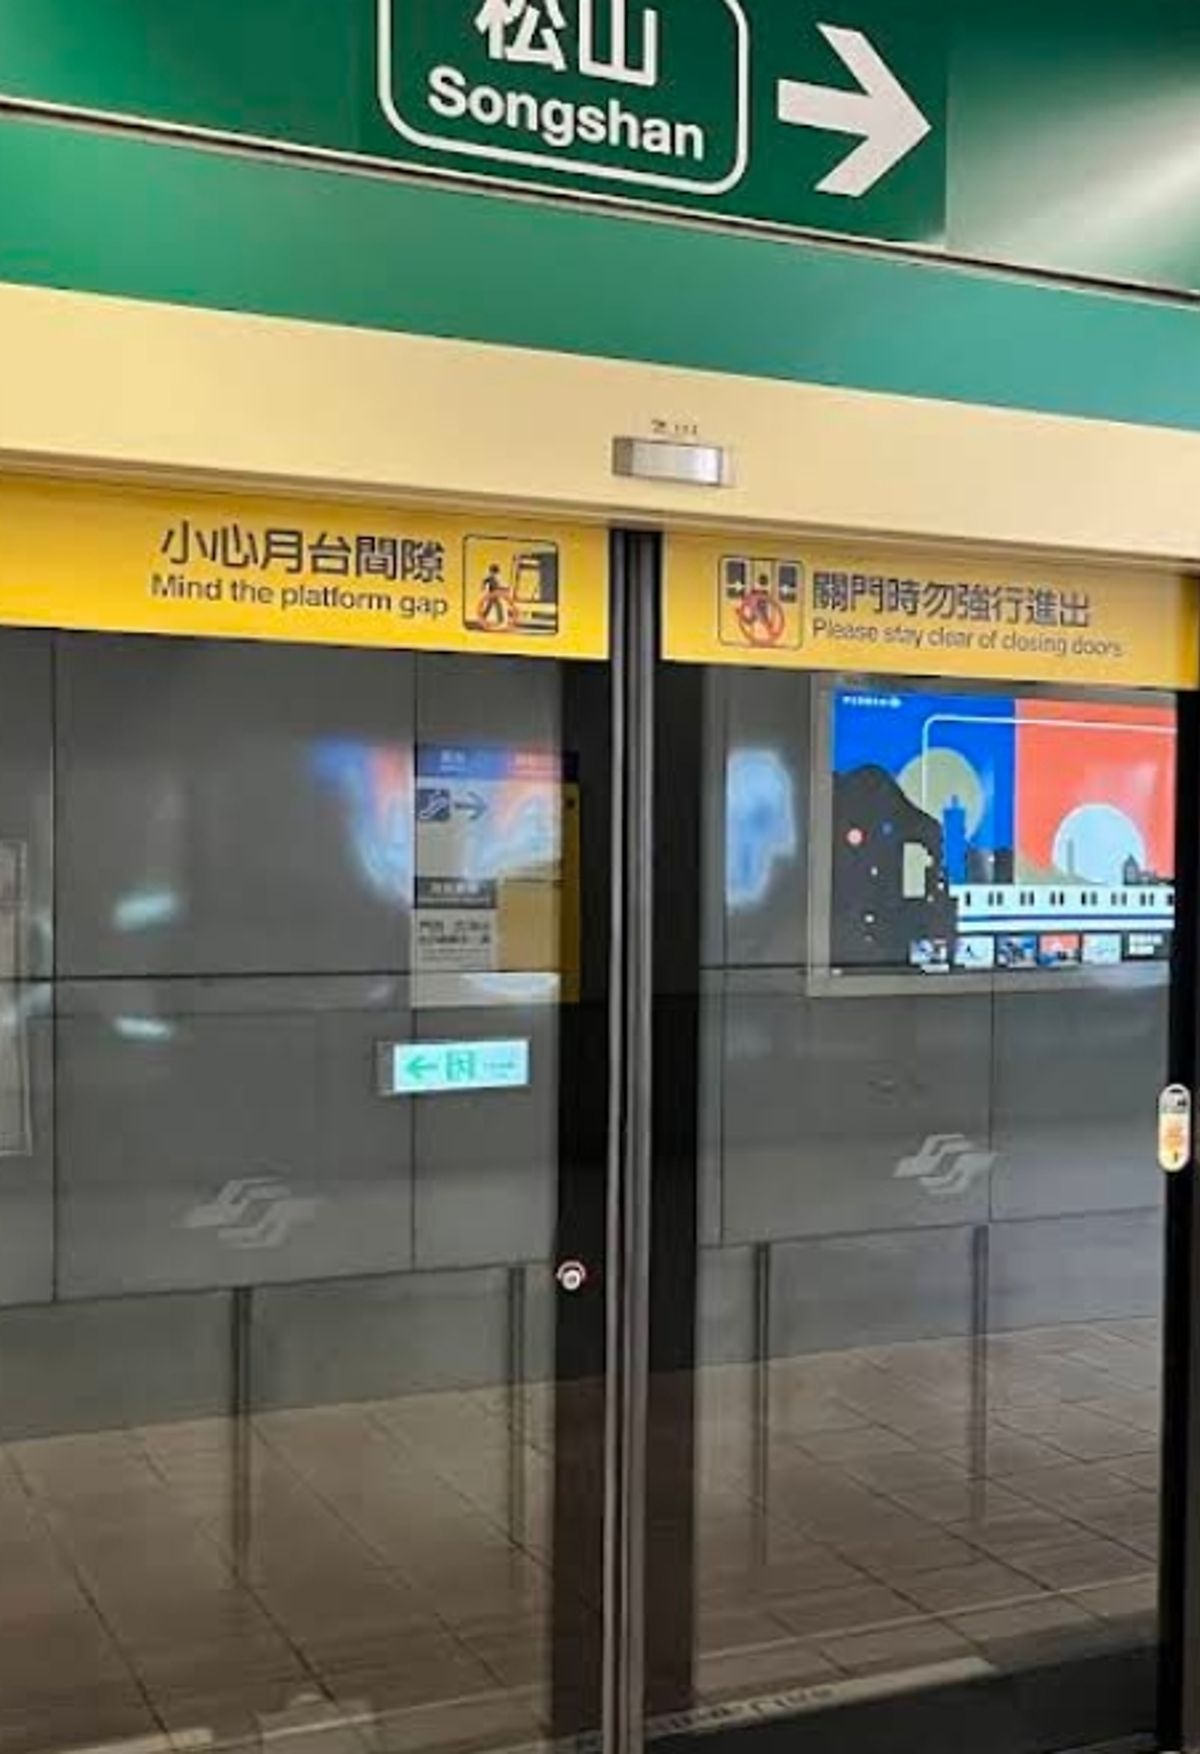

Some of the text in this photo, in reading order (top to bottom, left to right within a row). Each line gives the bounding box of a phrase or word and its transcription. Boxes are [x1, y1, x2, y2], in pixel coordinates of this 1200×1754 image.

[474, 0, 658, 87] 松山
[427, 65, 704, 161] Songshan
[160, 519, 446, 584] 小心月台間隙
[152, 573, 449, 620] Mind the platform gap
[812, 570, 1092, 629] 關門時勿強行進出
[812, 619, 1123, 659] Please stay clear of closing doors
